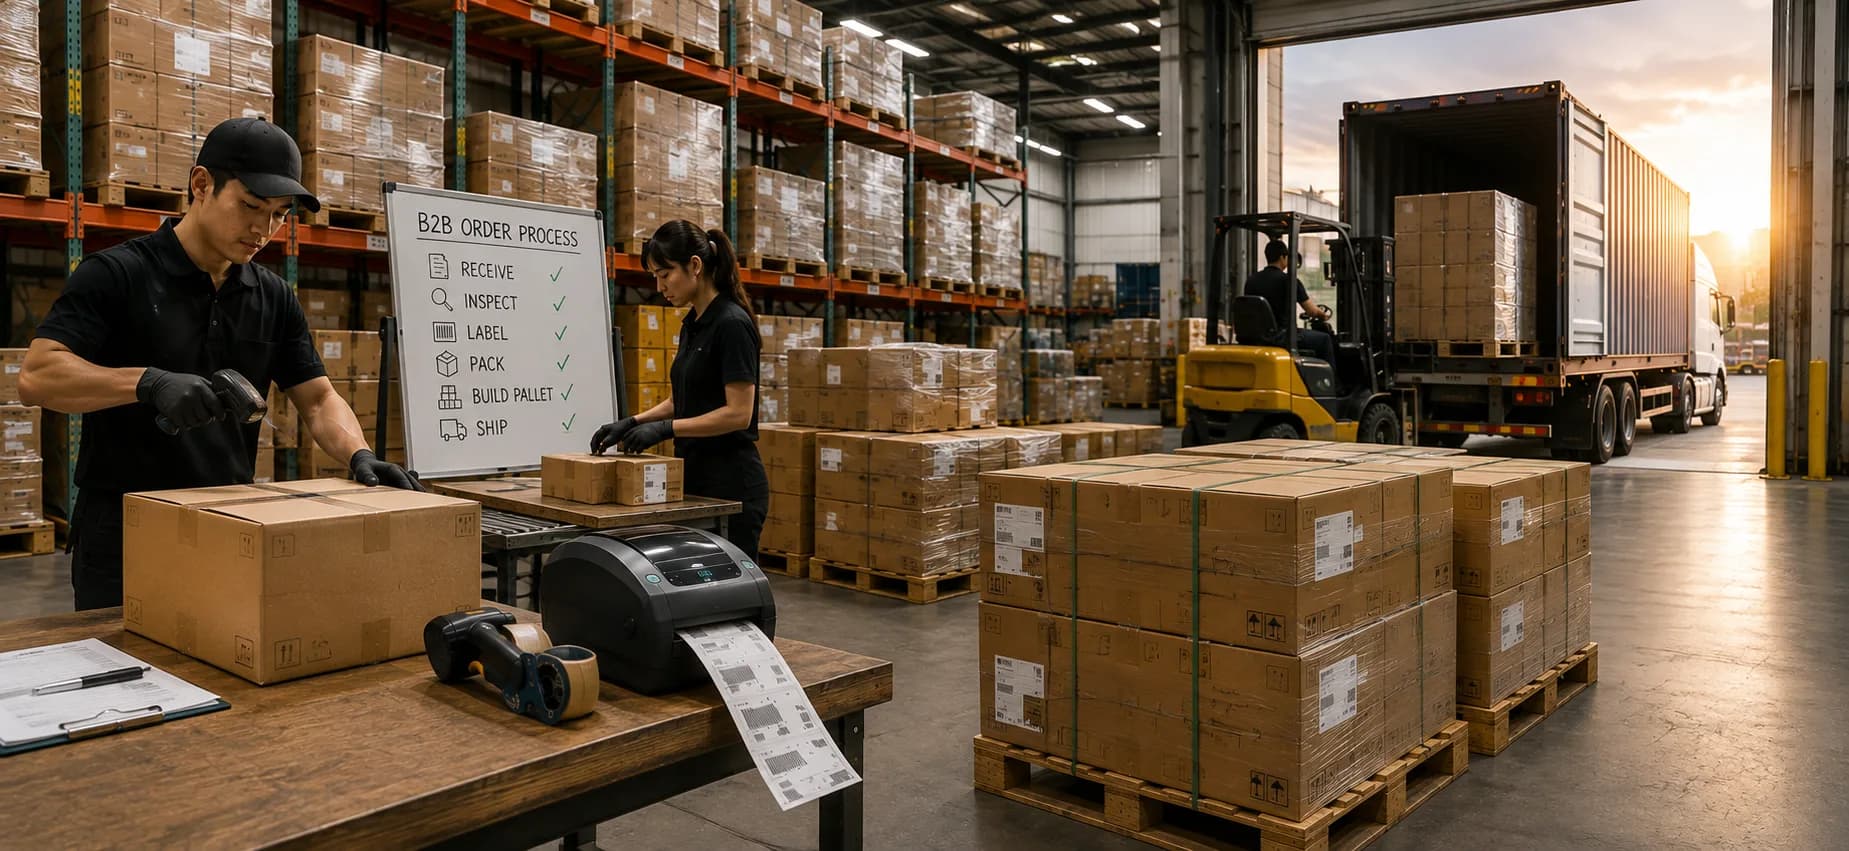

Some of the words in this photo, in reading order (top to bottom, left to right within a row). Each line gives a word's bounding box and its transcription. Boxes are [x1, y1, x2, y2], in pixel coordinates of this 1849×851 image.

[417, 212, 453, 235] B2B
[460, 218, 513, 241] ORDER
[519, 225, 579, 248] PROCESS
[461, 261, 515, 280] RECEIVE
[464, 293, 518, 311] INSPECT
[467, 325, 509, 341] LABEL
[470, 356, 505, 372] PACK
[473, 388, 509, 404] BUILD
[514, 387, 553, 402] PALLET
[476, 420, 508, 436] SHIP
